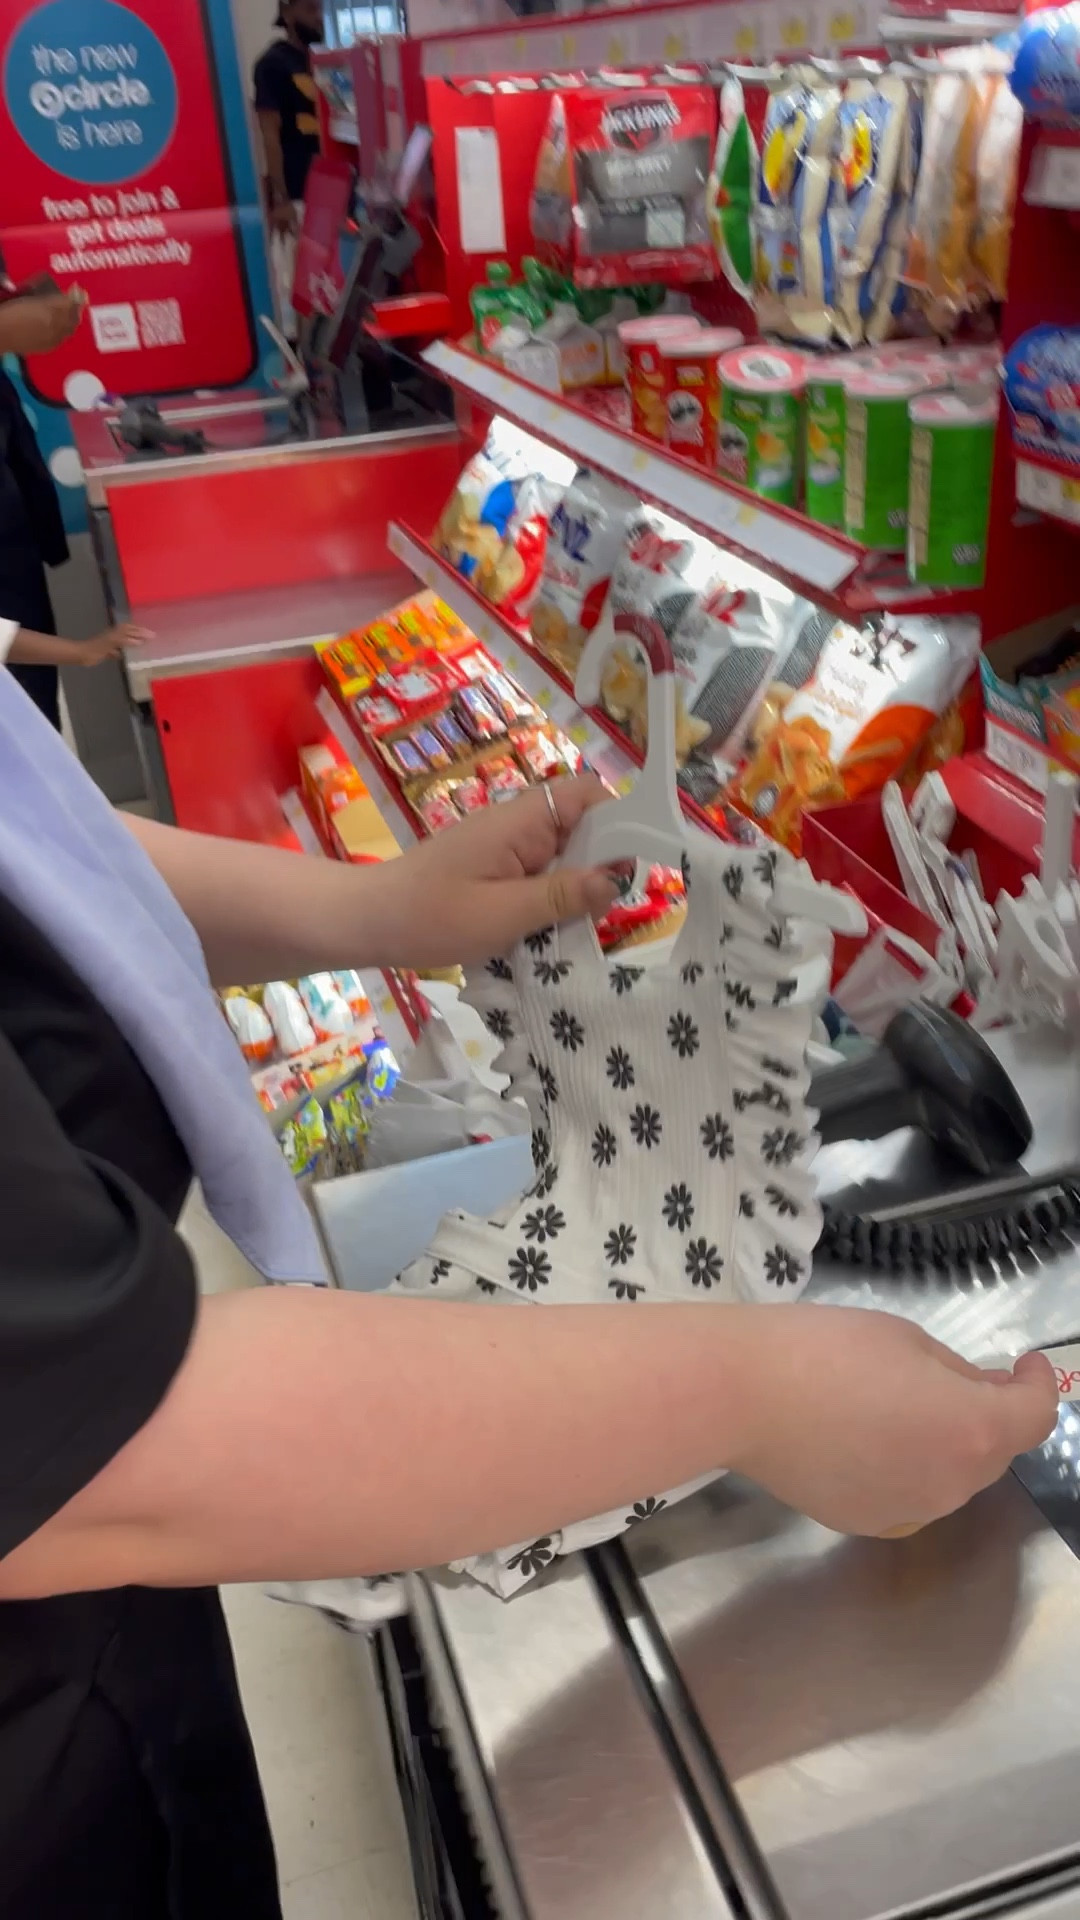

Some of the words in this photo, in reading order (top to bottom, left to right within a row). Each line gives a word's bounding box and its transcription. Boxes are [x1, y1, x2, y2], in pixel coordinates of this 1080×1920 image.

[31, 43, 77, 75] the
[80, 43, 138, 71] new
[55, 119, 80, 150] is
[81, 116, 142, 147] here
[42, 196, 88, 221] free
[90, 193, 116, 216] to
[116, 189, 158, 216] join
[160, 185, 180, 210] &
[67, 220, 105, 250] get
[107, 215, 166, 241] deals
[50, 238, 191, 274] automatically
